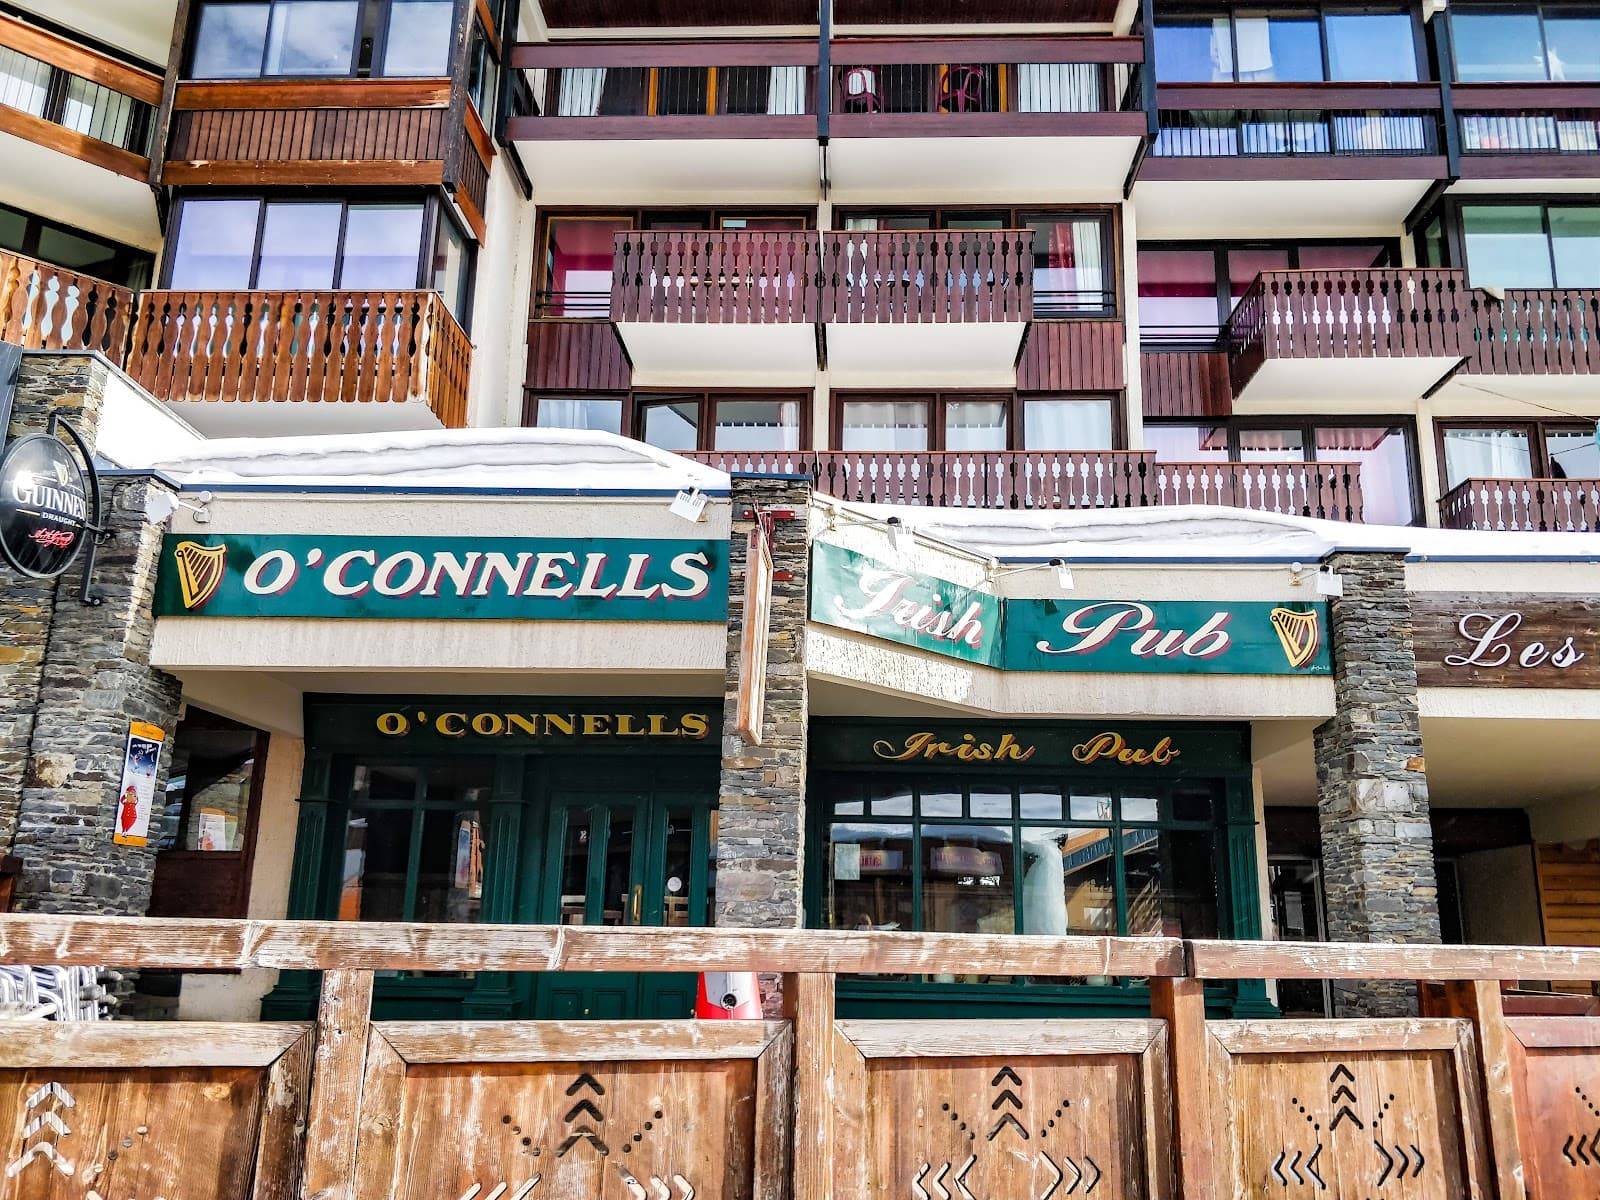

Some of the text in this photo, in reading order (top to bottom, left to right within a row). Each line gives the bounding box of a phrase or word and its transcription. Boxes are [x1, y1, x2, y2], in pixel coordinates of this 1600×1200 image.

[42, 512, 76, 527] DRAUGHT
[243, 548, 711, 599] O'CONNELLS
[833, 563, 1232, 659] Irish Pub
[1444, 612, 1585, 668] Les
[376, 711, 709, 738] O'CONNELLS
[873, 732, 1180, 765] Irish Pub
